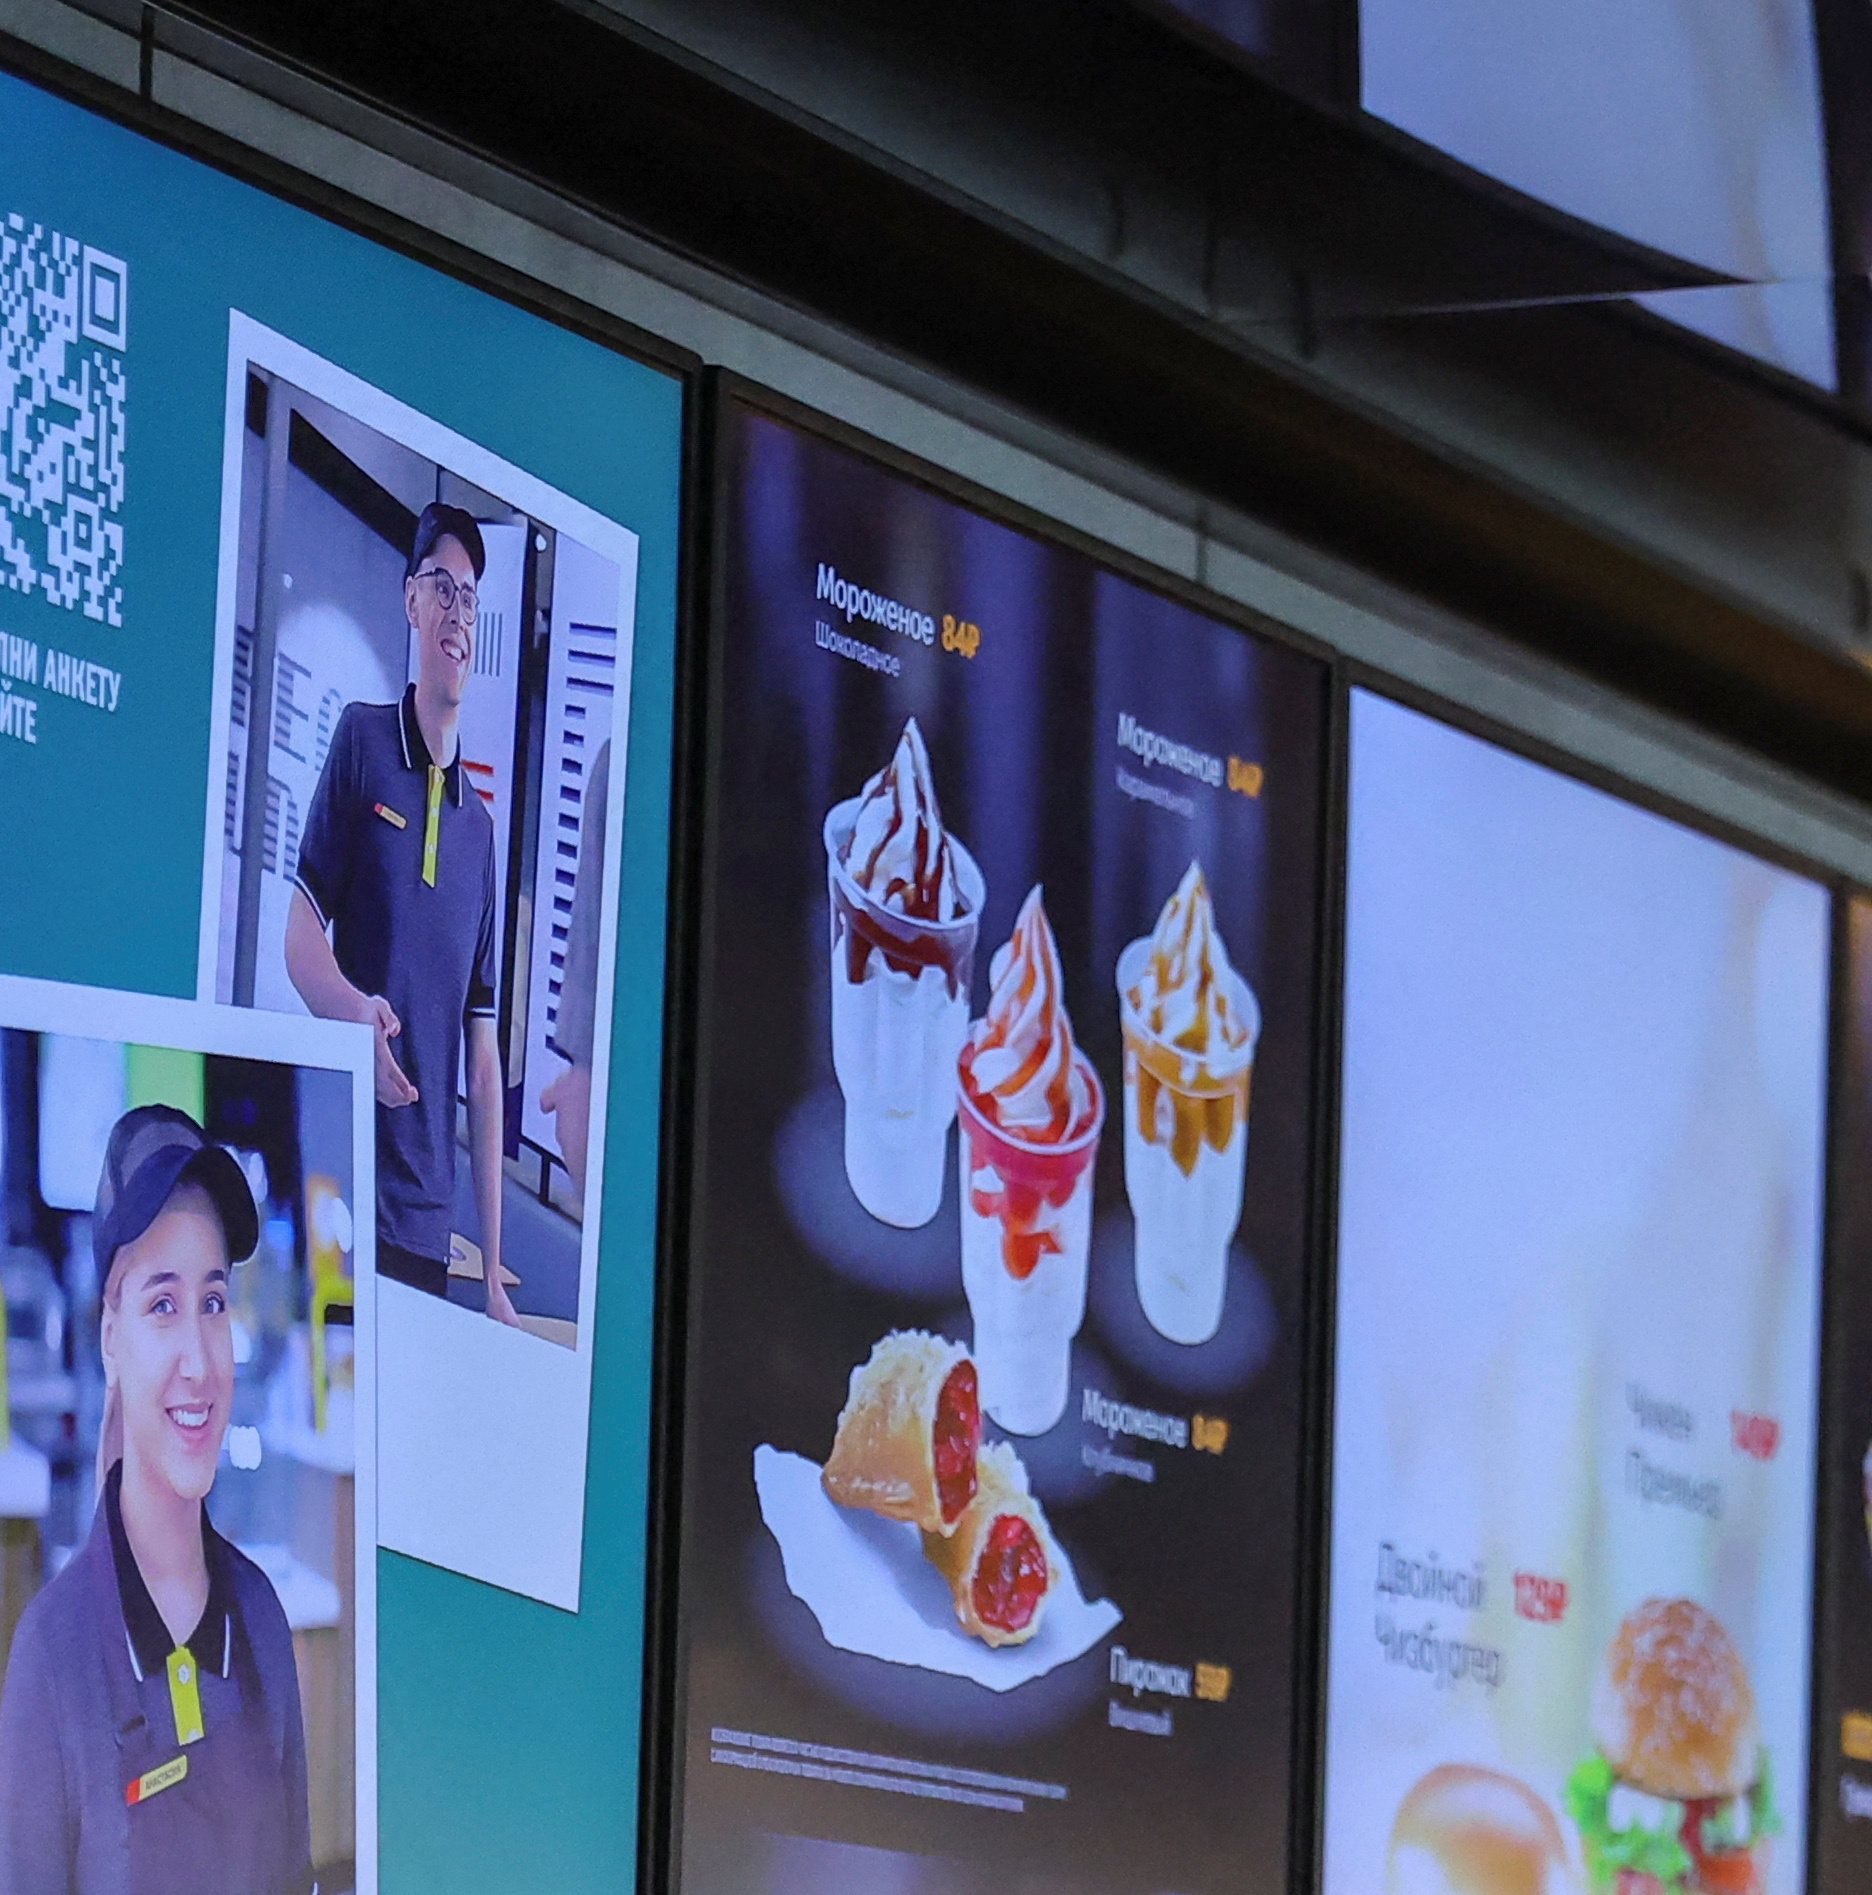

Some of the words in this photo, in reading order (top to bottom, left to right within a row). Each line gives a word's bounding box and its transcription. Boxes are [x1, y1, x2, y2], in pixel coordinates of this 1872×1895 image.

[816, 562, 935, 645] Мороженое
[44, 648, 121, 713] АНКЕТУ
[815, 619, 901, 678] Шоколадное
[1118, 711, 1224, 788] Мороженое
[1082, 1389, 1188, 1450] Мороженое
[1377, 1540, 1485, 1611] Двойной
[1375, 1612, 1505, 1694] Чизбургер
